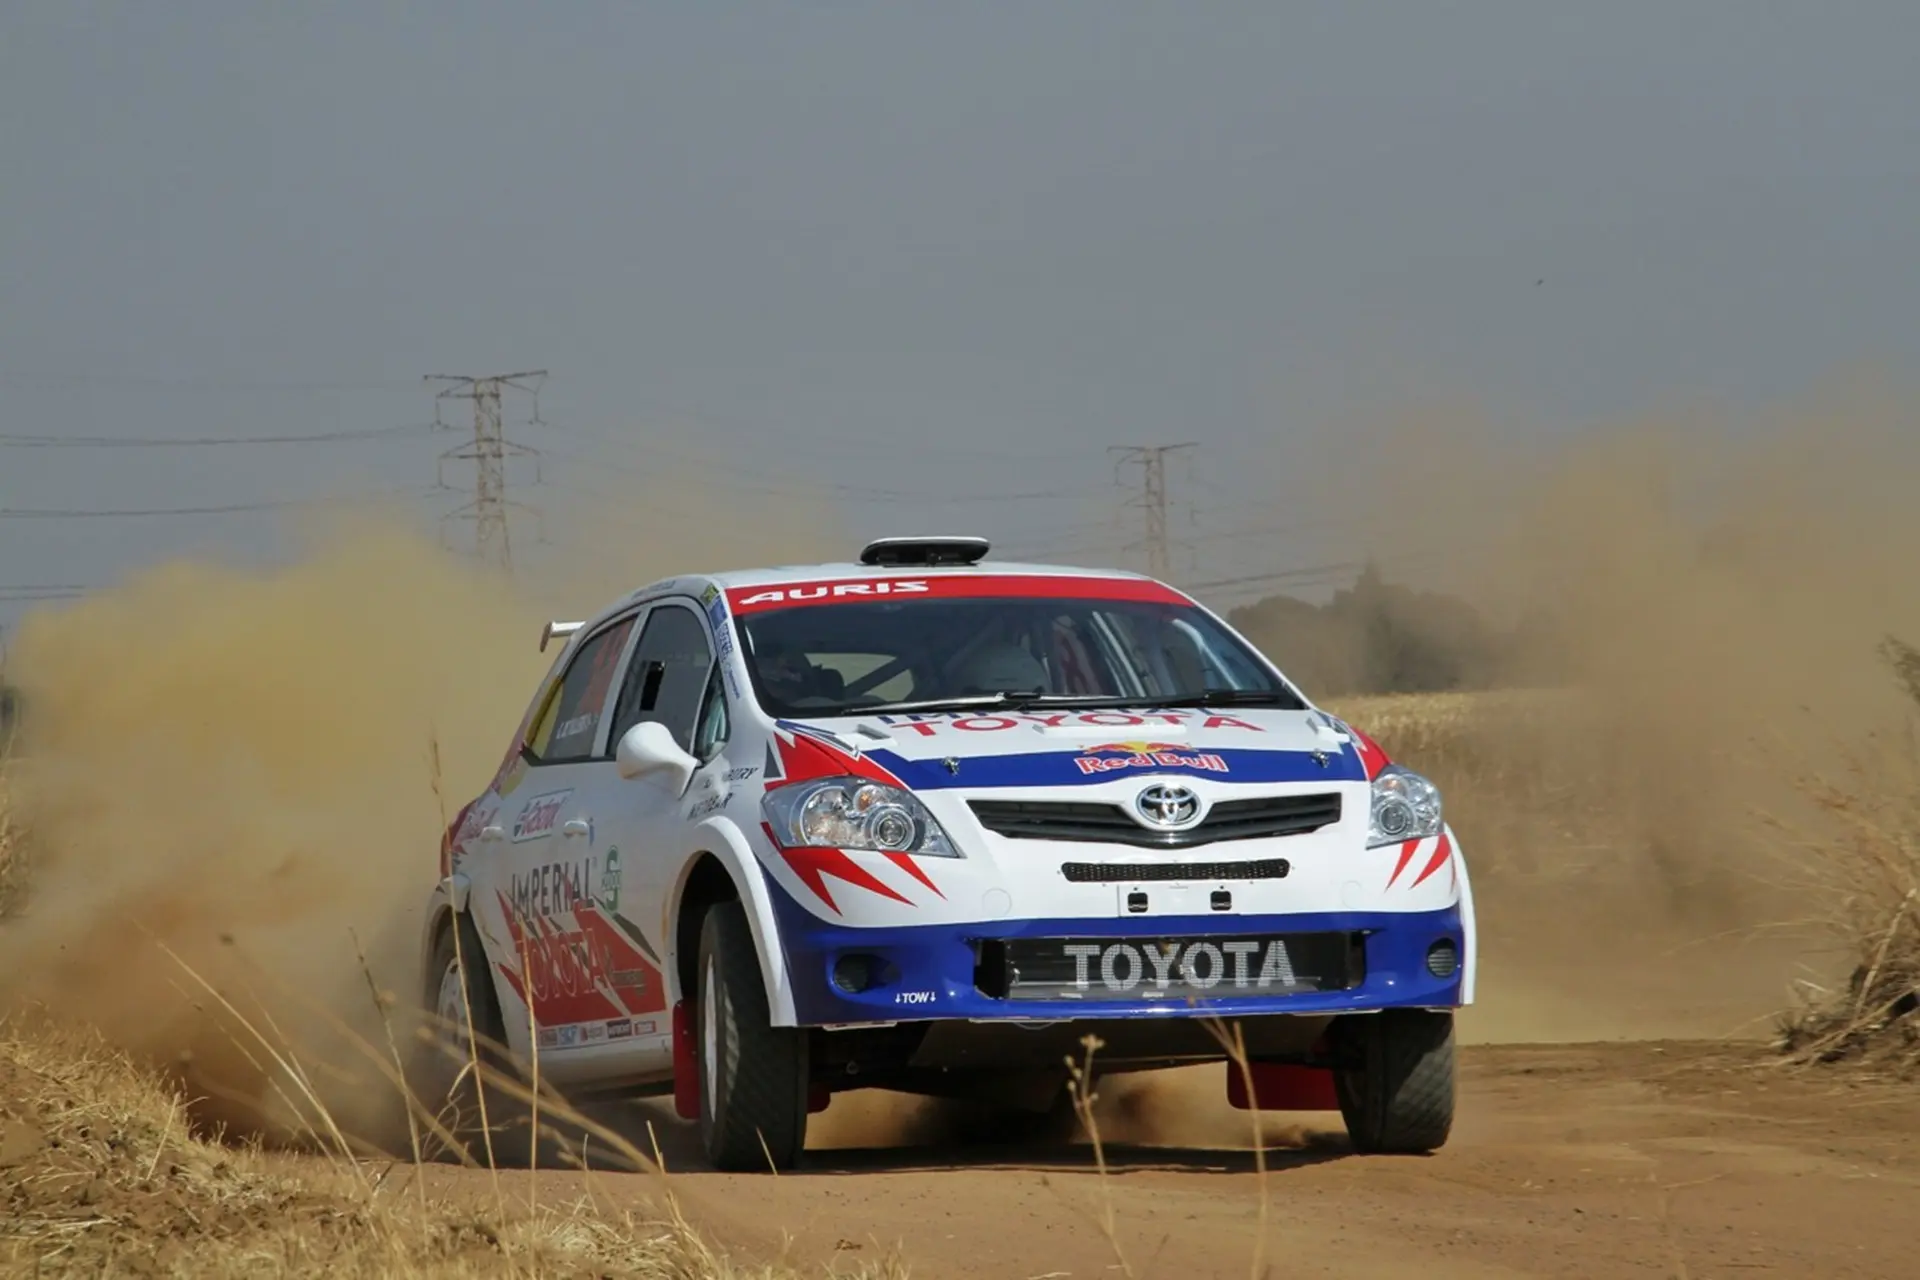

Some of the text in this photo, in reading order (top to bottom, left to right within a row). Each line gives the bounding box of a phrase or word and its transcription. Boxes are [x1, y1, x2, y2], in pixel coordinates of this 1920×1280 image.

[739, 581, 929, 605] AURIS
[890, 713, 1267, 737] TOYOTA
[1074, 752, 1230, 775] Red Bull
[511, 857, 596, 922] IMPERIAL
[1063, 940, 1297, 992] TOYOTA
[902, 991, 930, 1004] TOW
